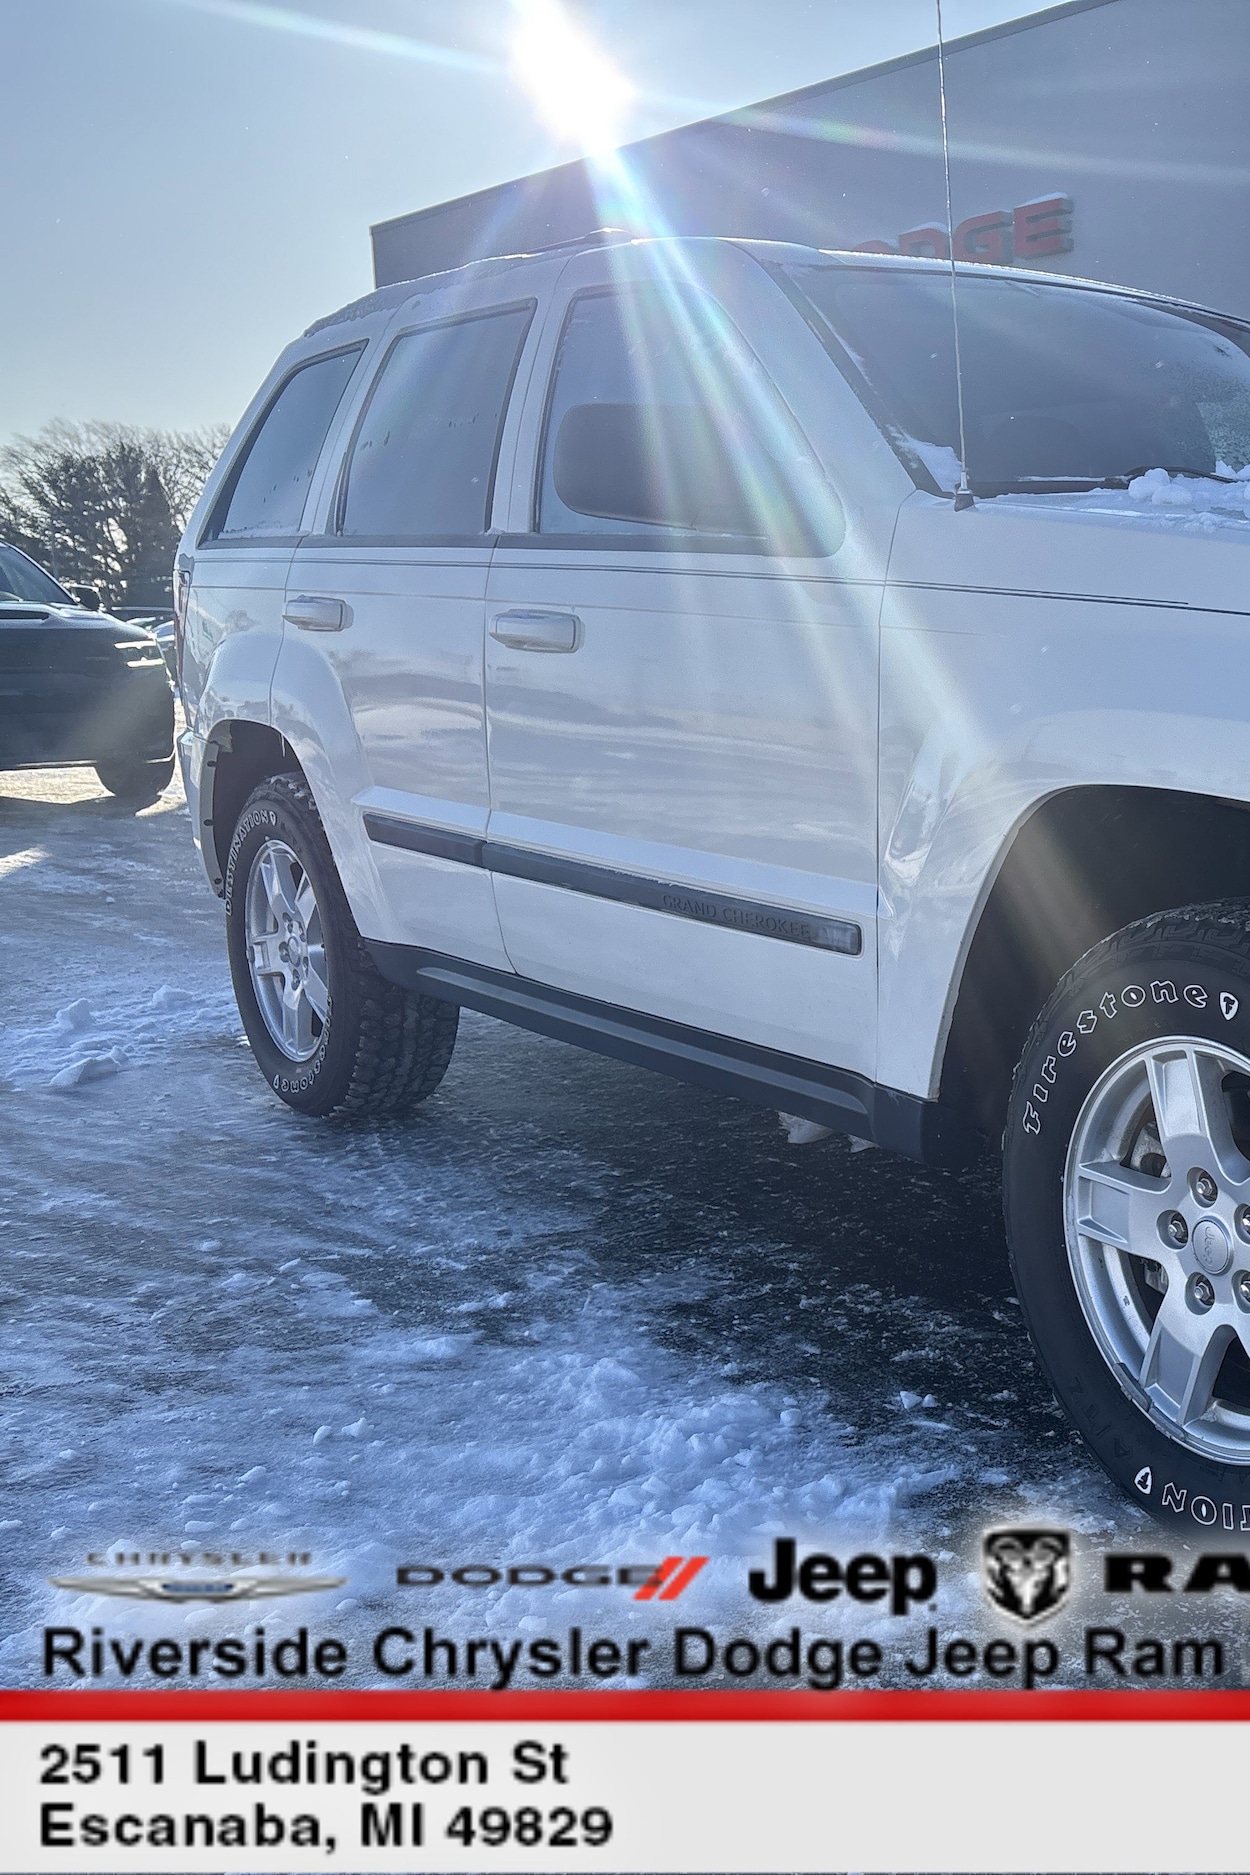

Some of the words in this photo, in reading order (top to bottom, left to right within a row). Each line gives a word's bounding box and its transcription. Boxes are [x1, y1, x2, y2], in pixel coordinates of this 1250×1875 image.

[662, 894, 717, 918] GRAND
[723, 907, 810, 938] CHEROKEE
[1022, 979, 1209, 1136] Firestone
